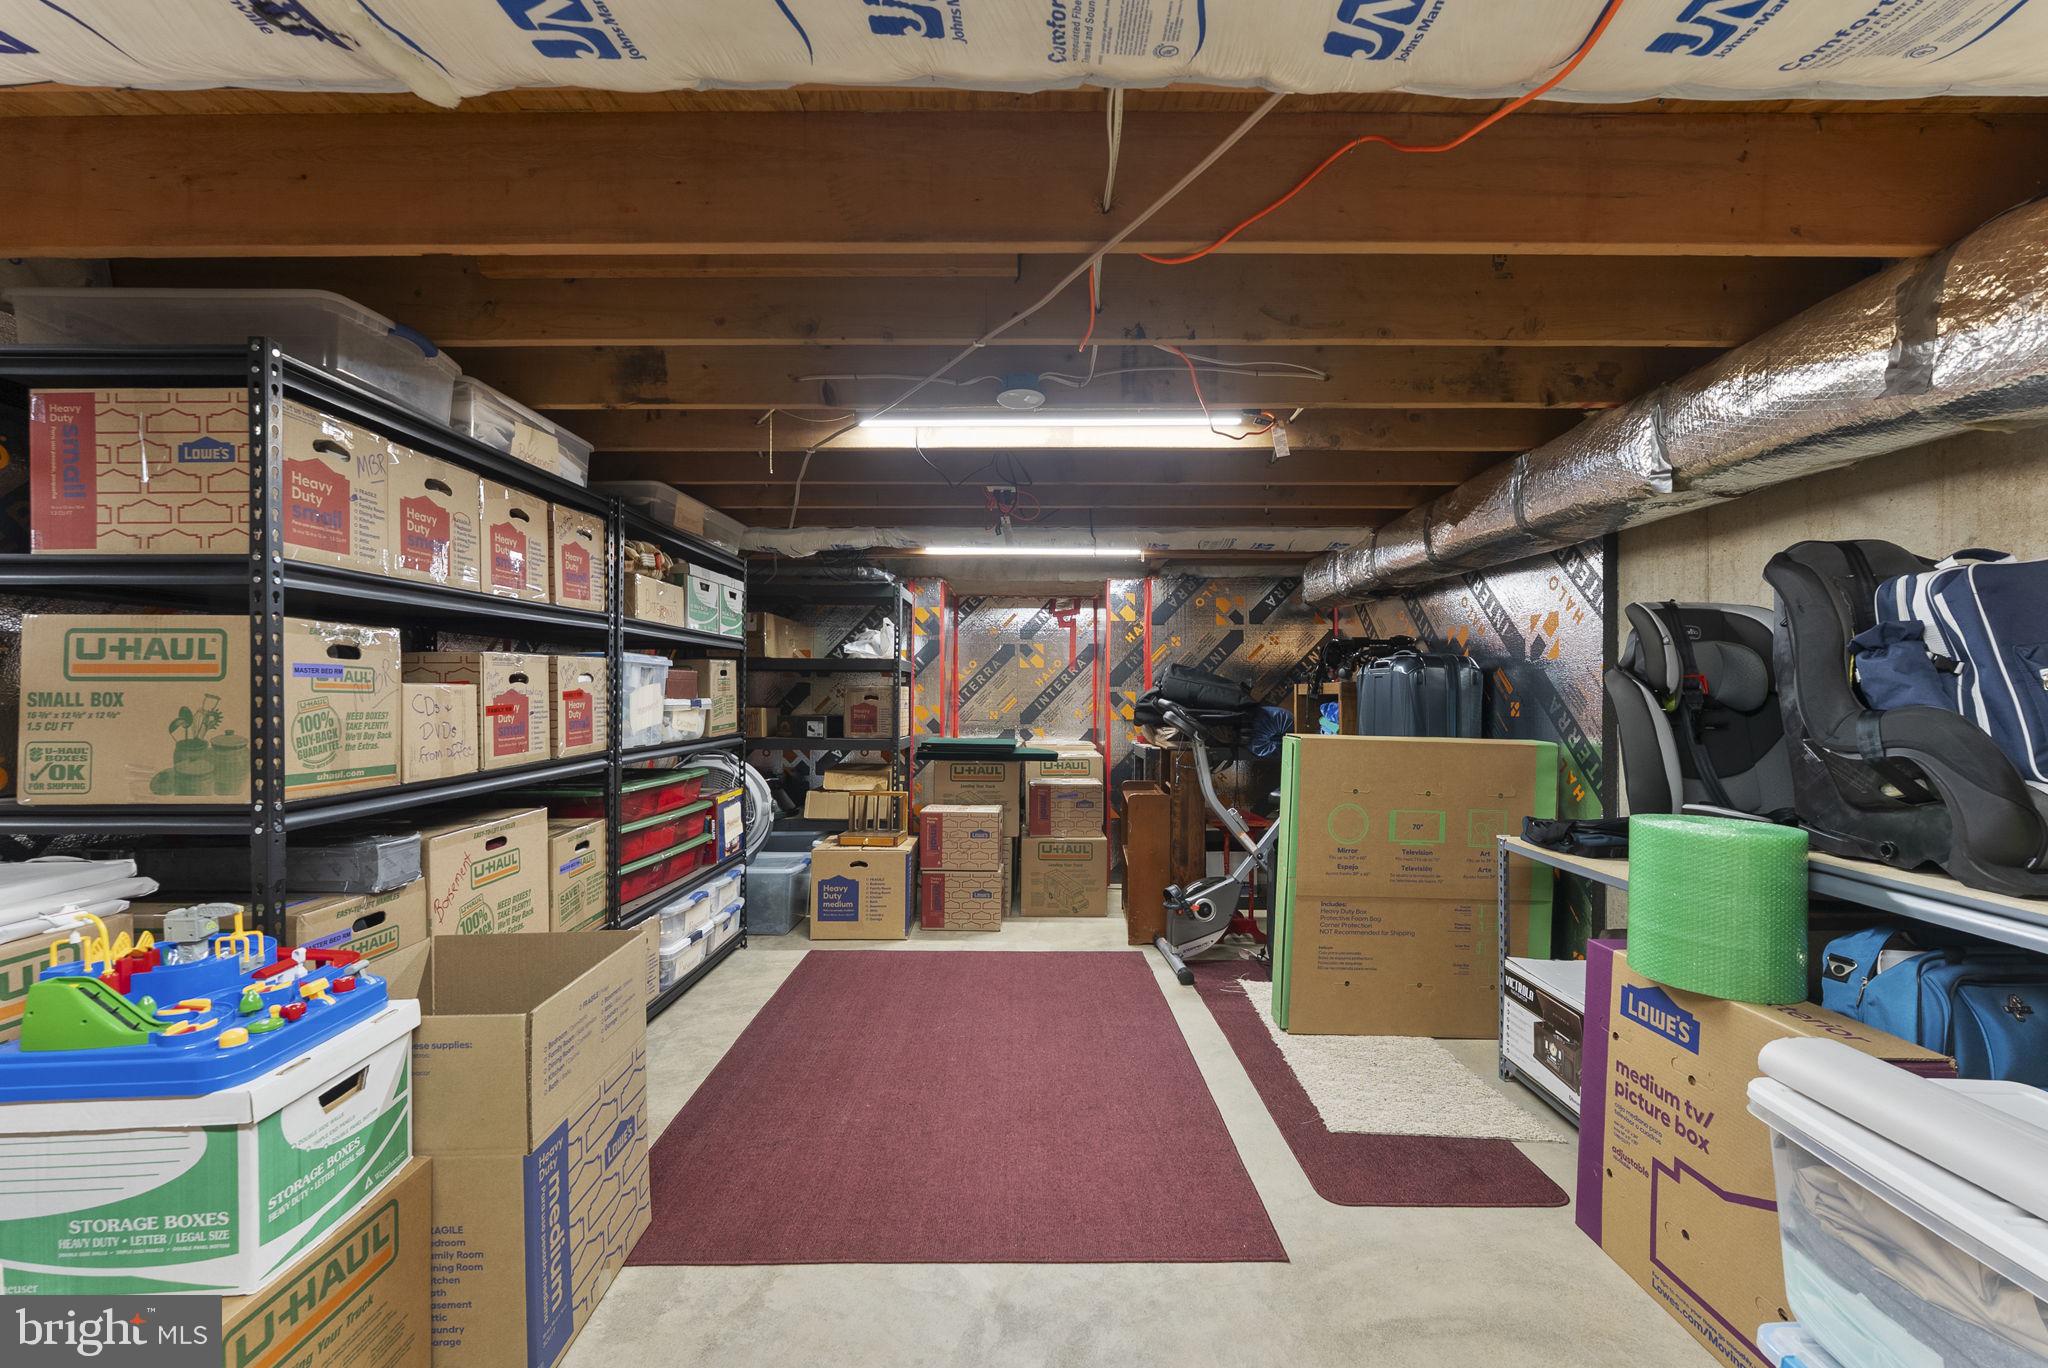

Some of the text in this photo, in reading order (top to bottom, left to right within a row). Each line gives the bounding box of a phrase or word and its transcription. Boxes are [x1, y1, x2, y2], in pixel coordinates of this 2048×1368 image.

[48, 404, 82, 414] Heavy
[49, 414, 74, 423] Duty
[184, 446, 230, 460] LOWE'S
[63, 424, 86, 498] small
[291, 471, 334, 496] Heavy
[291, 487, 324, 507] Duty
[291, 504, 343, 529] small
[406, 507, 438, 527] Heavy
[407, 520, 431, 537] Duty
[494, 532, 518, 548] Heavy
[565, 552, 583, 564] Heavy
[565, 561, 579, 573] Duty
[76, 638, 217, 661] U-HAUL
[294, 667, 321, 675] MASTER
[957, 660, 1001, 706] NTERRA
[27, 692, 124, 707] SMALL BOX
[568, 702, 587, 711] Heavy
[297, 711, 334, 734] 100%
[346, 712, 364, 721] NEED
[498, 715, 515, 724] Duty
[568, 711, 582, 720] Duty
[27, 722, 74, 731] 1.5 CU FT
[345, 722, 363, 730] TAKE
[419, 721, 457, 740] DVDs
[296, 728, 339, 749] BUY-BACK
[345, 732, 392, 741] We'll Buy Back
[345, 743, 356, 751] the
[48, 764, 86, 780] OK
[954, 766, 1002, 775] U-HAUL
[1043, 762, 1087, 770] U-HAUL
[316, 770, 365, 781] uhaul.com
[1041, 844, 1091, 854] U-HAUL
[1402, 848, 1434, 856] Television
[474, 853, 518, 878] U-HAUL
[823, 885, 849, 893] Heavy
[823, 892, 843, 900] Duty
[460, 907, 488, 935] 100%
[342, 932, 352, 940] RM
[1628, 992, 1691, 1045] LOWE'S
[1767, 1003, 1872, 1043] terior
[431, 1040, 473, 1051] supplies:
[1615, 1058, 1715, 1129] medium tv/
[1615, 1079, 1671, 1128] picture
[1675, 1114, 1710, 1155] box
[607, 1122, 634, 1162] LOWE'S
[538, 1136, 564, 1169] Heavy
[1611, 1145, 1650, 1179] adjustable
[267, 1136, 361, 1210] STORAGE BOXES
[538, 1156, 558, 1184] Duty
[267, 1204, 291, 1223] HEAVY
[290, 1190, 309, 1206] DUTY
[314, 1168, 336, 1189] LETTER
[69, 1211, 231, 1235] STORAGE BOXES
[431, 1226, 464, 1235] AGILE
[58, 1229, 230, 1250] HEAVY DUTY LETTER LEGAL SIZE
[549, 1170, 566, 1313] medium
[456, 1250, 484, 1259] Room
[456, 1263, 484, 1271] Room
[235, 1221, 391, 1368] U-HAUL
[431, 1289, 447, 1298] ath
[431, 1301, 472, 1309] asement
[318, 1294, 373, 1354] Your Truck
[431, 1313, 448, 1321] ttic
[431, 1325, 465, 1335] aundry
[431, 1338, 462, 1348] arage
